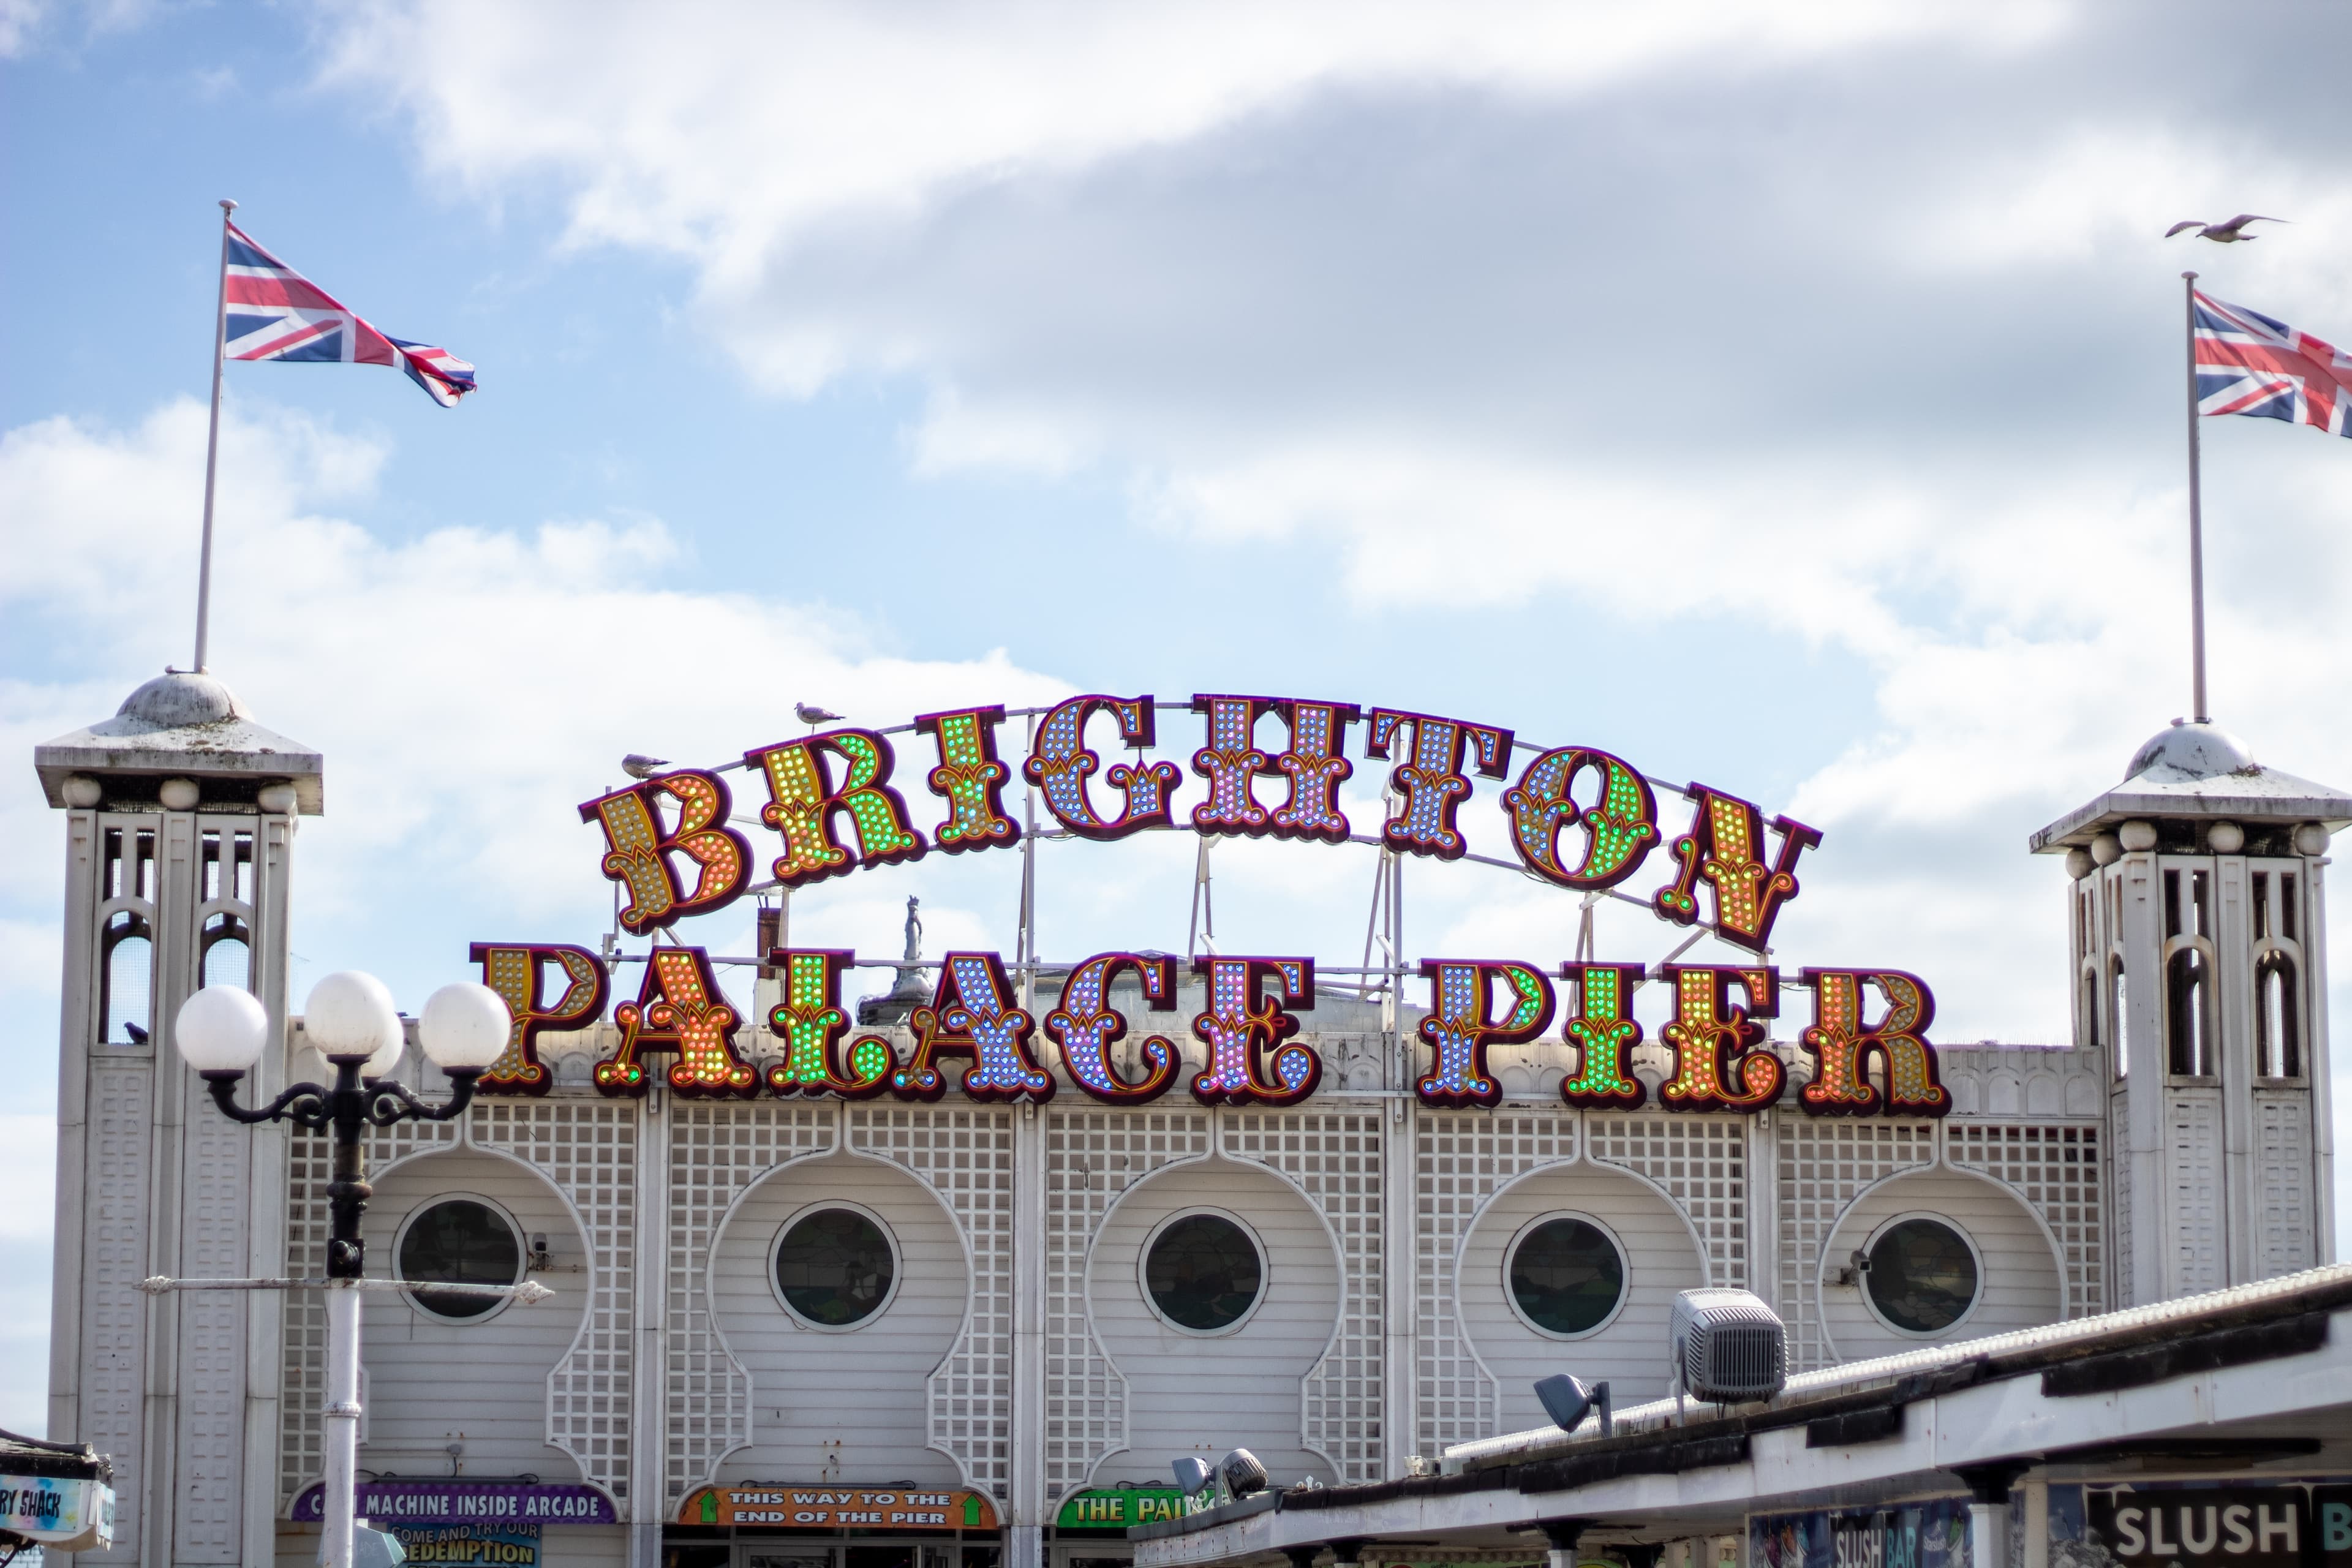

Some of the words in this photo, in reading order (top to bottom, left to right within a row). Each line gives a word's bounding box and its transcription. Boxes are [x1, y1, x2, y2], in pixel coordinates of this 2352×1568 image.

[578, 694, 1823, 953] BRIGHTON
[470, 941, 1323, 1106] PALACE
[1415, 957, 1953, 1118] PIER
[20, 1490, 61, 1518] SHACK
[367, 1494, 449, 1515] MACHINE
[457, 1494, 518, 1516] INSIDE
[525, 1495, 599, 1517] ARCADE
[729, 1492, 784, 1504] THIS
[792, 1493, 853, 1505] WAY
[859, 1493, 896, 1506] TO
[904, 1493, 951, 1506] THE
[1073, 1497, 1125, 1521] THE
[734, 1511, 785, 1523] END
[794, 1511, 829, 1523] OF
[835, 1511, 883, 1524] THE
[891, 1512, 947, 1525] PIER
[2116, 1504, 2298, 1556] SLUSH
[391, 1526, 434, 1544] COME
[438, 1526, 471, 1542] AND
[475, 1523, 502, 1536] TRY
[507, 1522, 538, 1538] OUR
[401, 1541, 534, 1564] EDEMPTION
[1837, 1529, 1882, 1568] SLUSH
[1887, 1526, 1917, 1568] BAR
